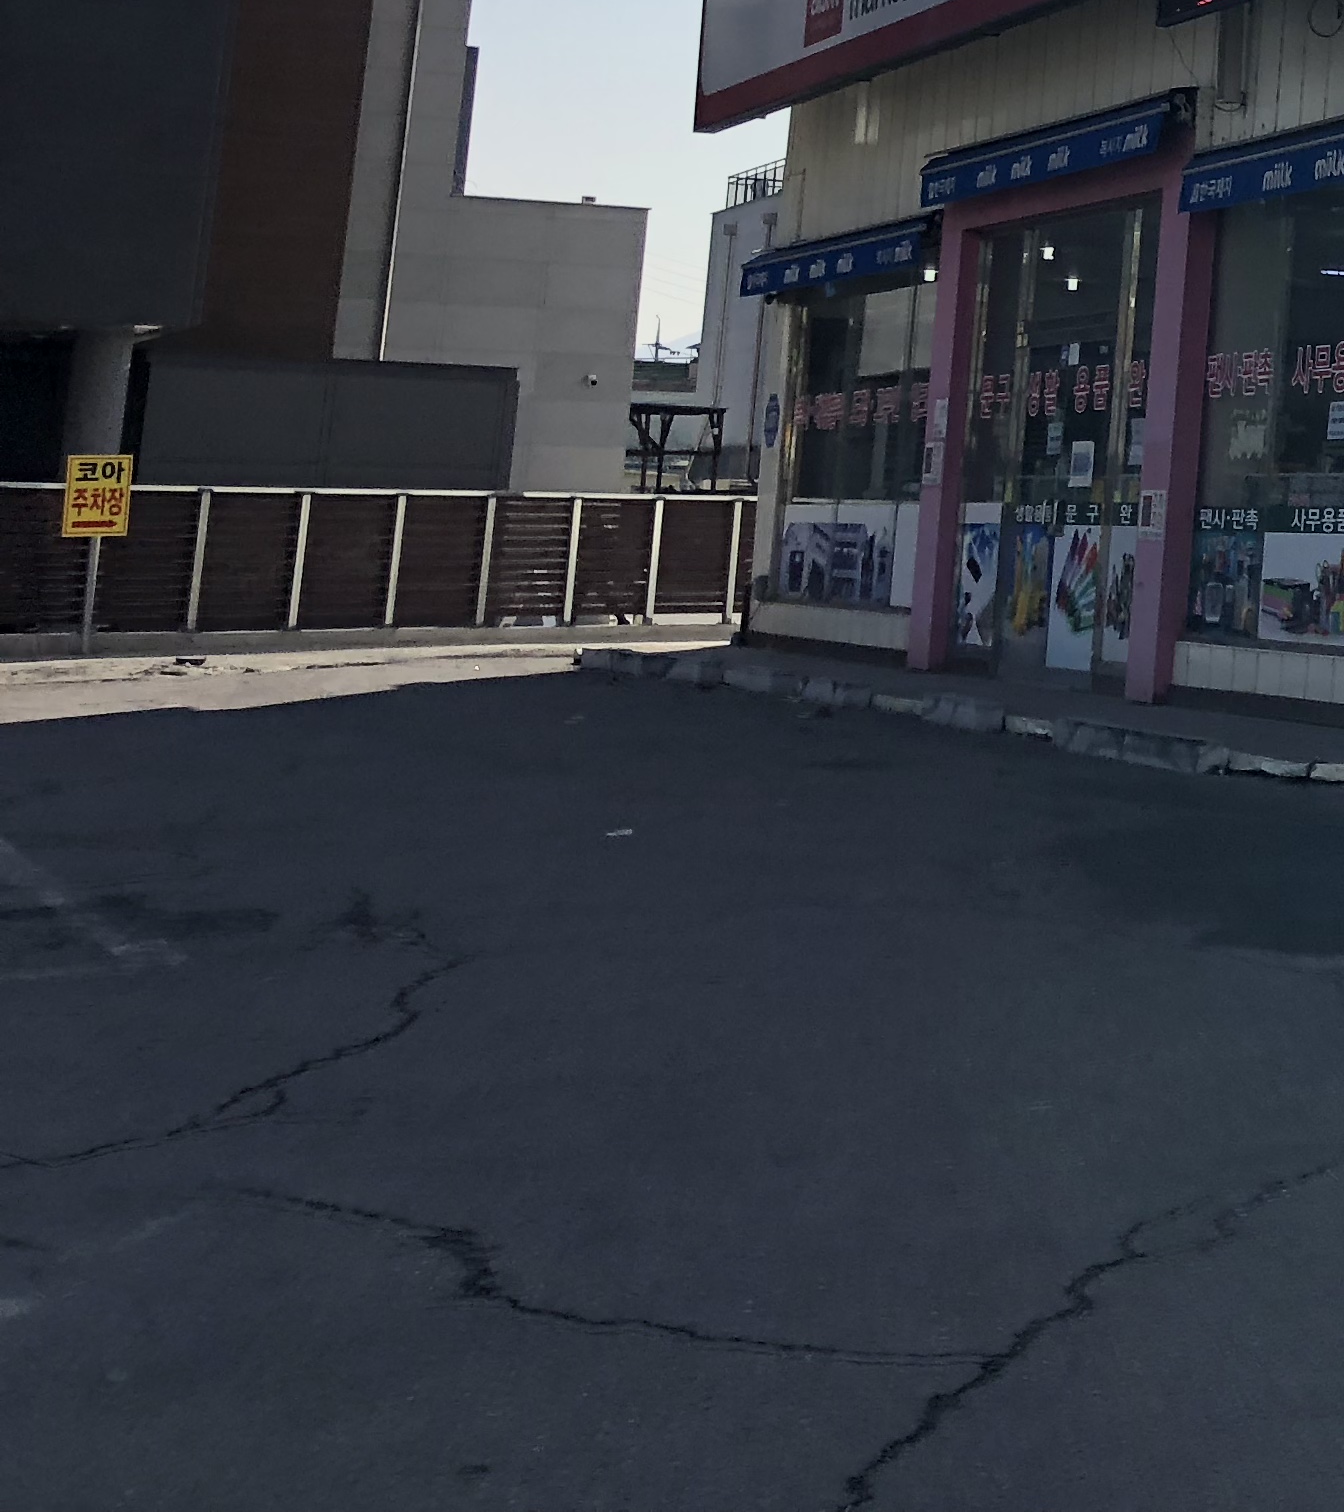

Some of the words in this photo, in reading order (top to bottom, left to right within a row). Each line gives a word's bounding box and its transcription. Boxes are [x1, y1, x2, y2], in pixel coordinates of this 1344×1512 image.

[75, 461, 126, 484] 코아
[71, 487, 125, 517] 주차장
[1066, 504, 1100, 524] 문구
